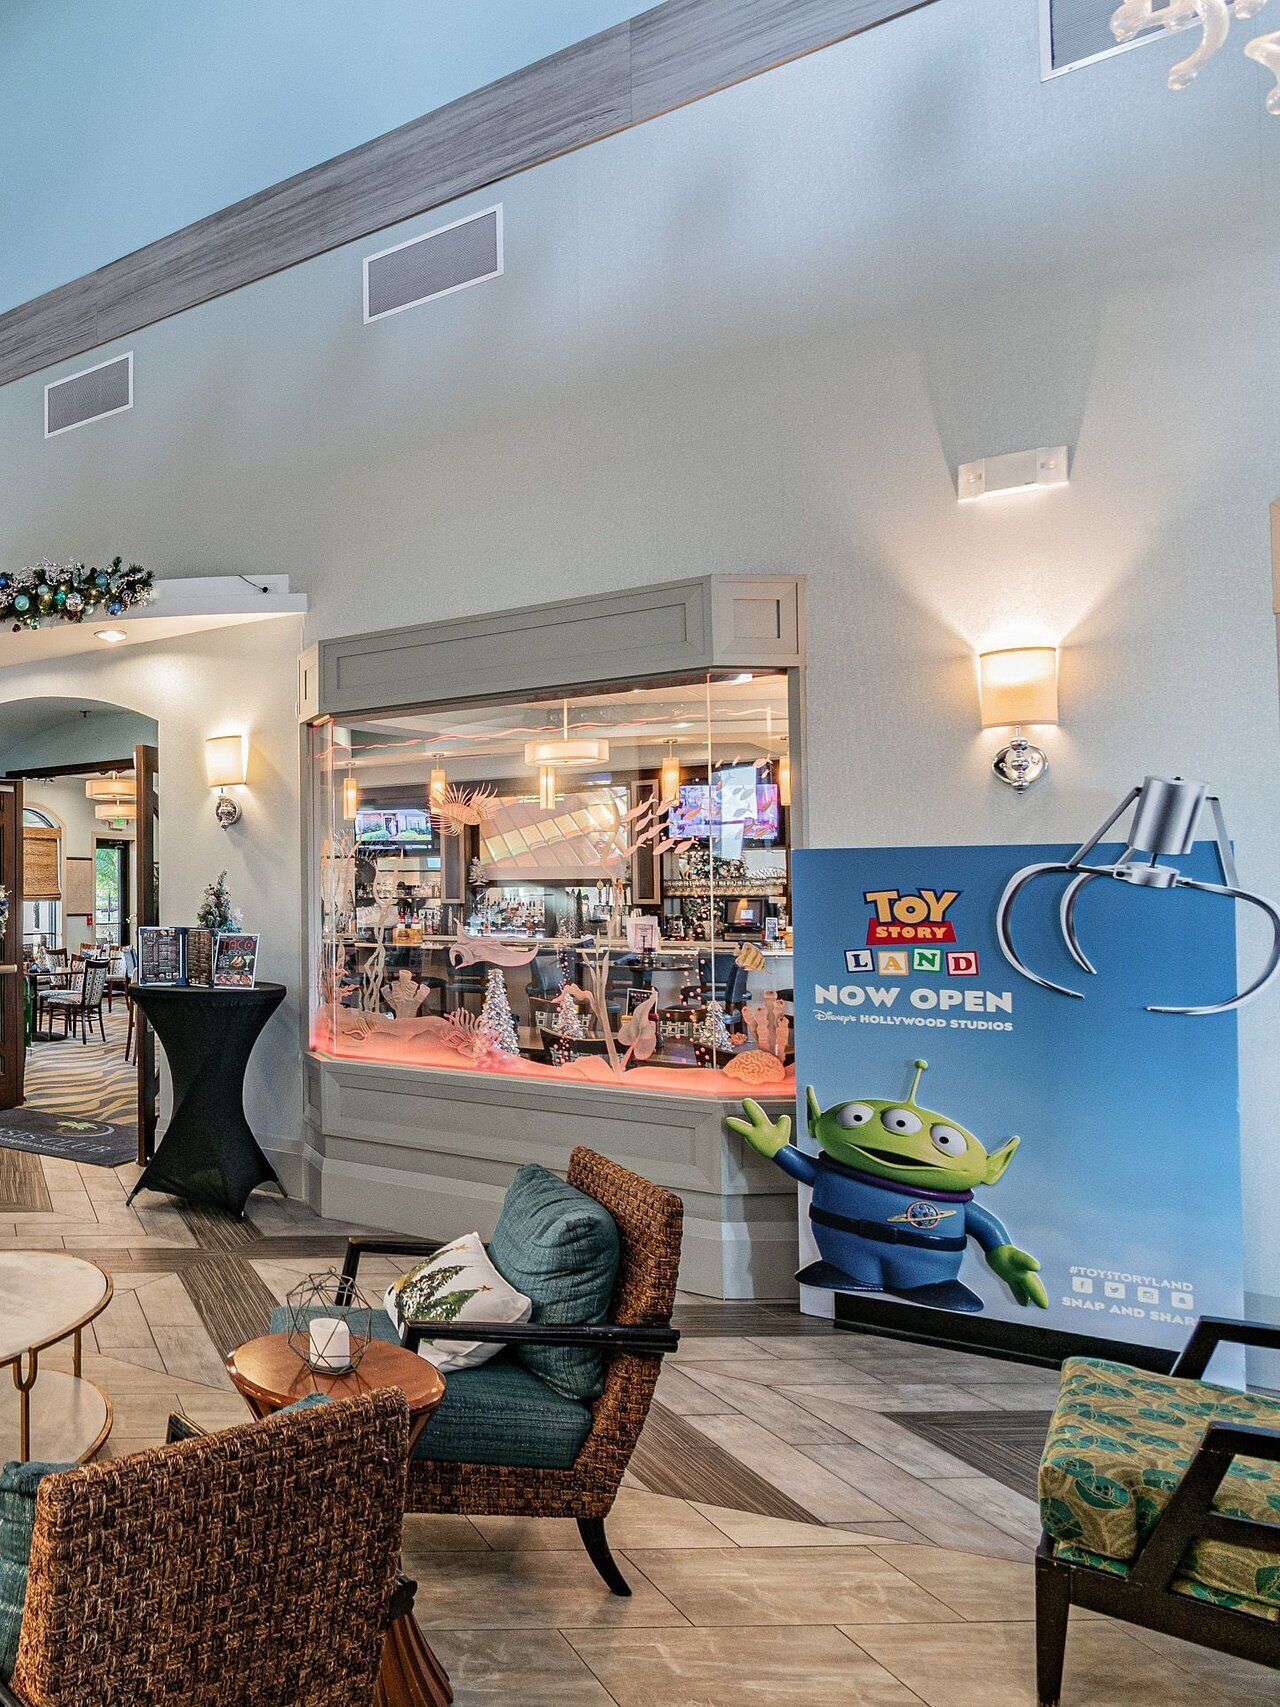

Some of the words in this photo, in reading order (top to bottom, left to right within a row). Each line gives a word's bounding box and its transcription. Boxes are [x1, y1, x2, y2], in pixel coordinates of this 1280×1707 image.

[864, 888, 961, 924] TOY
[875, 926, 948, 939] STORY
[222, 940, 254, 950] TACO
[850, 951, 974, 972] LAND
[814, 983, 901, 1008] NOW
[909, 988, 1013, 1014] OPEN
[812, 1009, 858, 1025] Disney's
[859, 1014, 947, 1028] HOLLYWOOD
[950, 1019, 1013, 1032] STUDIOS
[1070, 1266, 1194, 1291] #TOYSTORYLAND
[1061, 1296, 1105, 1311] SNAP
[1109, 1305, 1146, 1318] AND
[1149, 1311, 1197, 1327] SHAR
